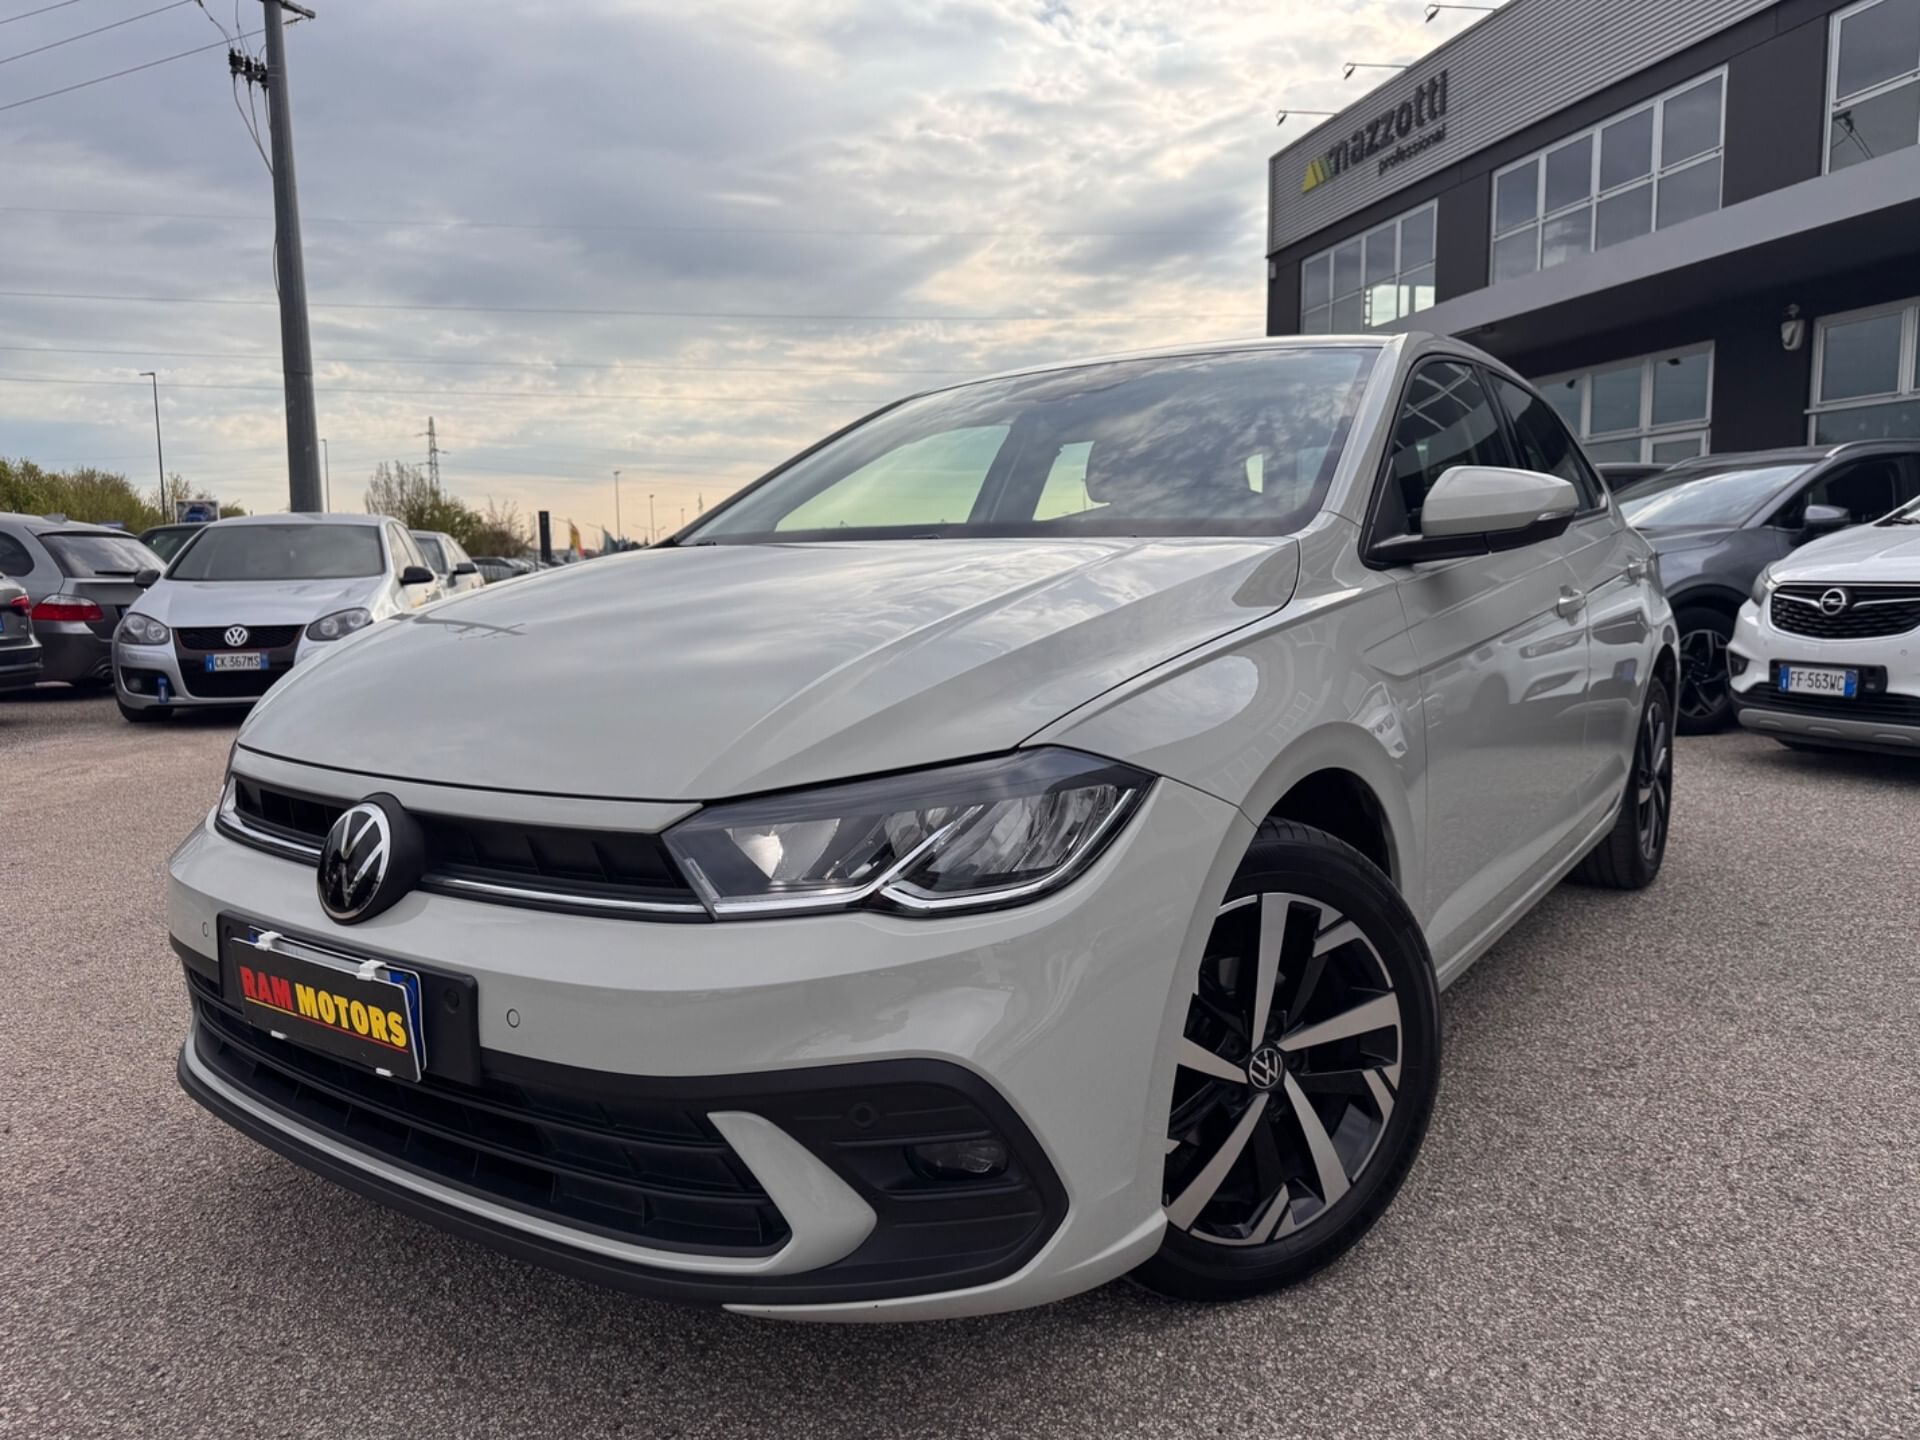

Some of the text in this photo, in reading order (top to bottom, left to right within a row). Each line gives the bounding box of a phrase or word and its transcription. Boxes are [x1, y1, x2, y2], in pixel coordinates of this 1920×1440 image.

[1327, 69, 1448, 176] mazzotti
[1378, 123, 1446, 176] professional
[240, 966, 408, 1048] RAM MOTORS
